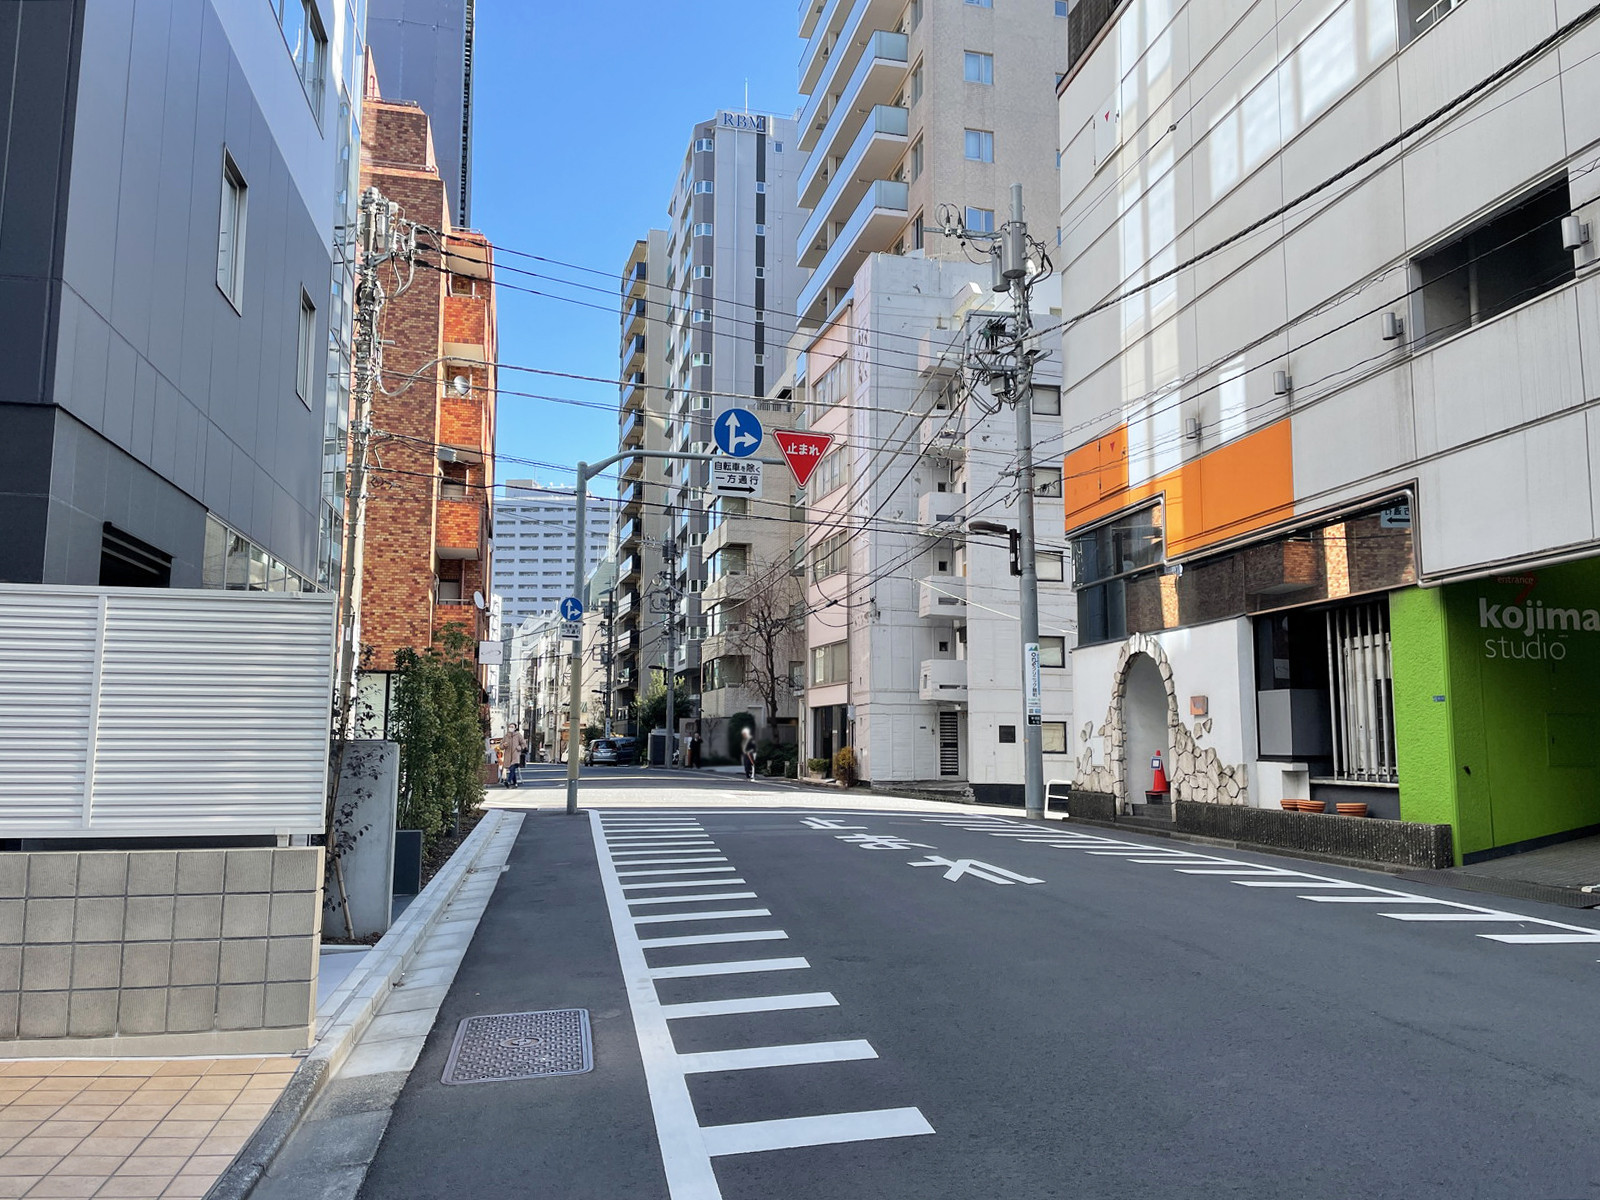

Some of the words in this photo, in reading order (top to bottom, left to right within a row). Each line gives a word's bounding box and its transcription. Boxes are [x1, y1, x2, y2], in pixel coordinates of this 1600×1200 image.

[723, 112, 764, 131] RBM
[786, 442, 820, 456] 止まれ
[714, 461, 760, 473] 自転車を除く
[715, 474, 759, 486] 一方通行
[1497, 576, 1534, 585] entrance
[1479, 597, 1600, 637] kojima
[1485, 633, 1566, 660] studio
